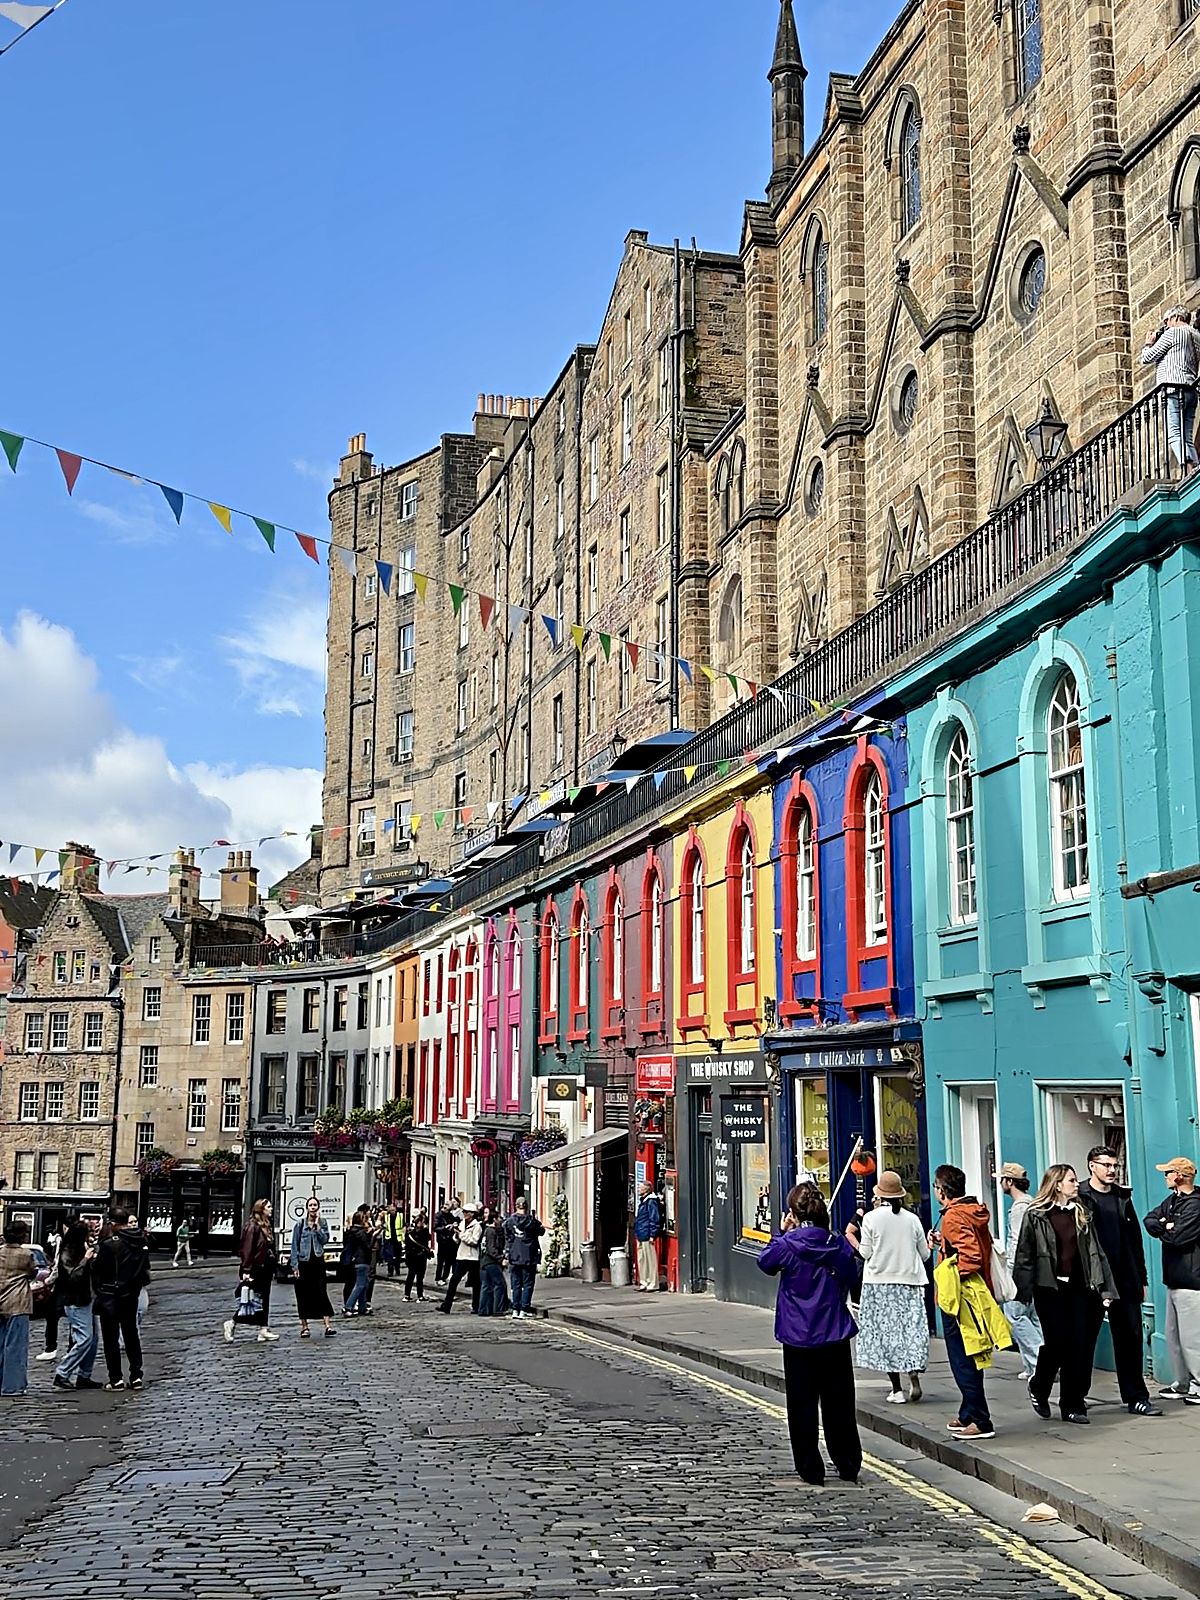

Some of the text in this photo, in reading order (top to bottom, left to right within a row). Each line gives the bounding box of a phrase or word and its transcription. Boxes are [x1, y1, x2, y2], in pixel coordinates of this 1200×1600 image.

[690, 1062, 704, 1077] THE
[704, 1056, 732, 1080] WHISKY
[733, 1059, 755, 1076] SHOP
[733, 1103, 753, 1112] THE
[724, 1114, 763, 1127] WHISKY
[730, 1130, 756, 1138] SHOP
